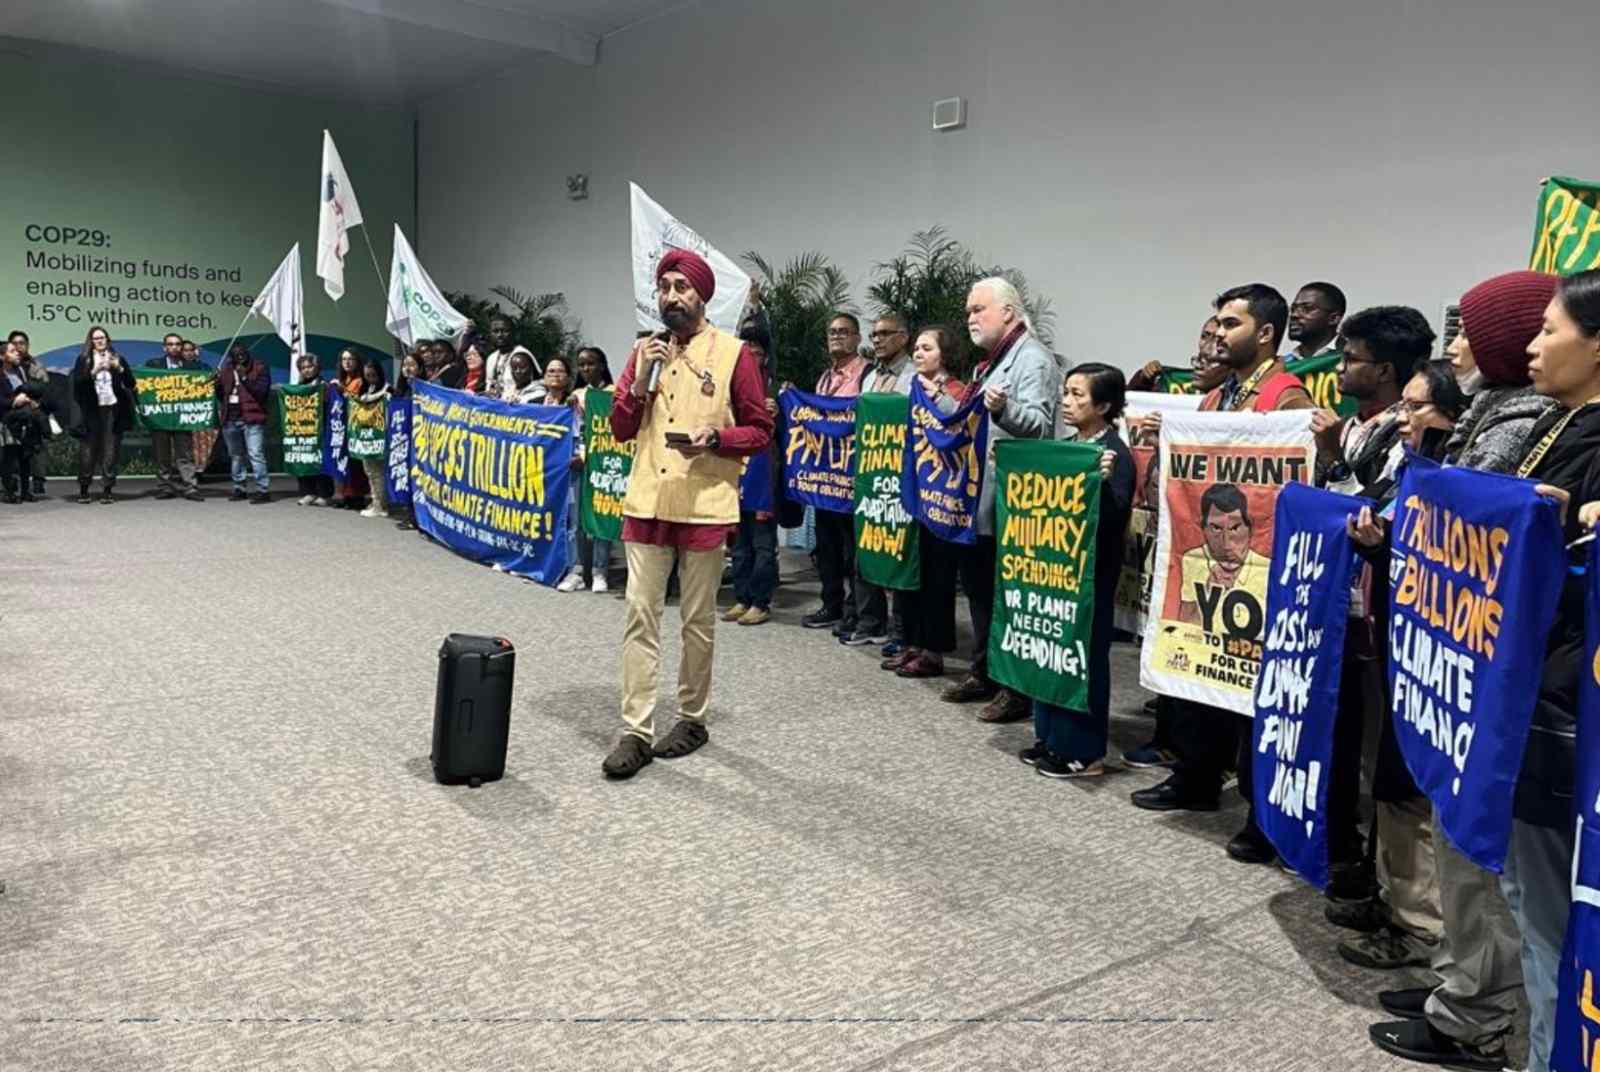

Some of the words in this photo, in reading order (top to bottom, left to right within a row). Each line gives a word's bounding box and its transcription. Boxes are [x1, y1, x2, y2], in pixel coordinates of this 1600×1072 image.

[25, 224, 111, 248] COP29:
[26, 250, 137, 279] Mobilizing
[142, 259, 200, 280] funds
[205, 266, 241, 283] and
[26, 280, 121, 302] enabling
[126, 287, 189, 304] action
[195, 288, 215, 305] to
[27, 303, 82, 323] 1.5°C
[87, 308, 150, 327] within
[155, 313, 217, 331] reach.
[179, 411, 213, 425] NOW!
[469, 408, 537, 436] GOVERNMENTS
[468, 432, 544, 507] TRILLION
[602, 456, 623, 470] FOR
[1170, 452, 1208, 480] WE
[1215, 455, 1307, 485] WANT
[872, 476, 901, 493] FOR
[1006, 471, 1087, 515] REDUCE
[441, 483, 484, 523] CLIMATE
[483, 498, 542, 540] FINANCE
[859, 520, 906, 562] NOW!
[1001, 508, 1088, 558] MILITARY
[1001, 550, 1088, 595] SPENDING!
[1280, 531, 1325, 586] FILL
[1027, 592, 1078, 624] PLANET
[1395, 554, 1504, 661] BILLIONS
[1013, 612, 1064, 637] NEEDS
[1204, 633, 1221, 648] TO
[1195, 663, 1255, 690] FINANCE
[1210, 653, 1237, 671] FOR
[1392, 613, 1475, 714] CLIMATE
